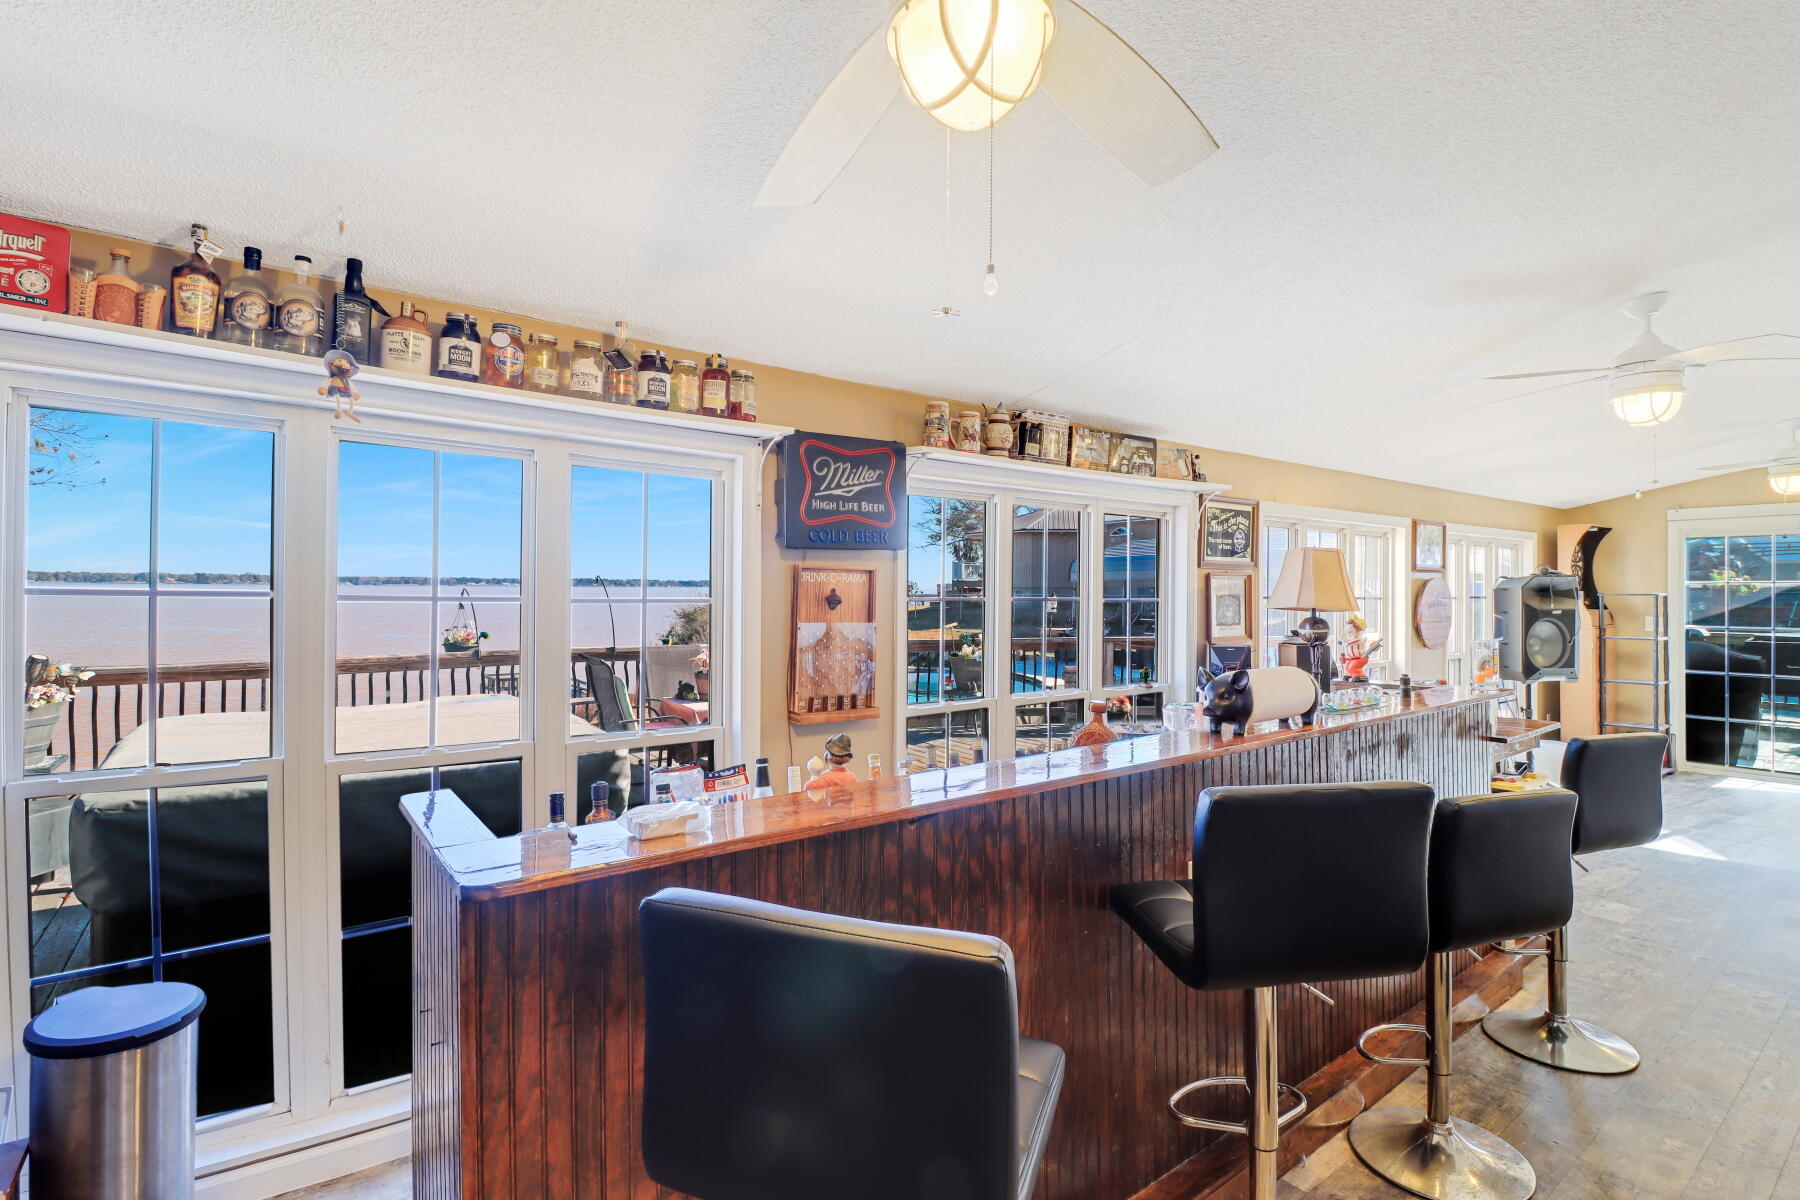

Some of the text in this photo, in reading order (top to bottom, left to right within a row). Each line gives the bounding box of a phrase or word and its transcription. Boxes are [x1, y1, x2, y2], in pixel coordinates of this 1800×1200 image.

[0, 229, 45, 252] rquell
[0, 291, 26, 301] ILSNER
[388, 347, 422, 357] MOONSINE
[450, 353, 471, 363] MOON
[648, 384, 667, 393] MOON
[812, 456, 884, 491] Miller
[809, 529, 889, 544] COLD BEER
